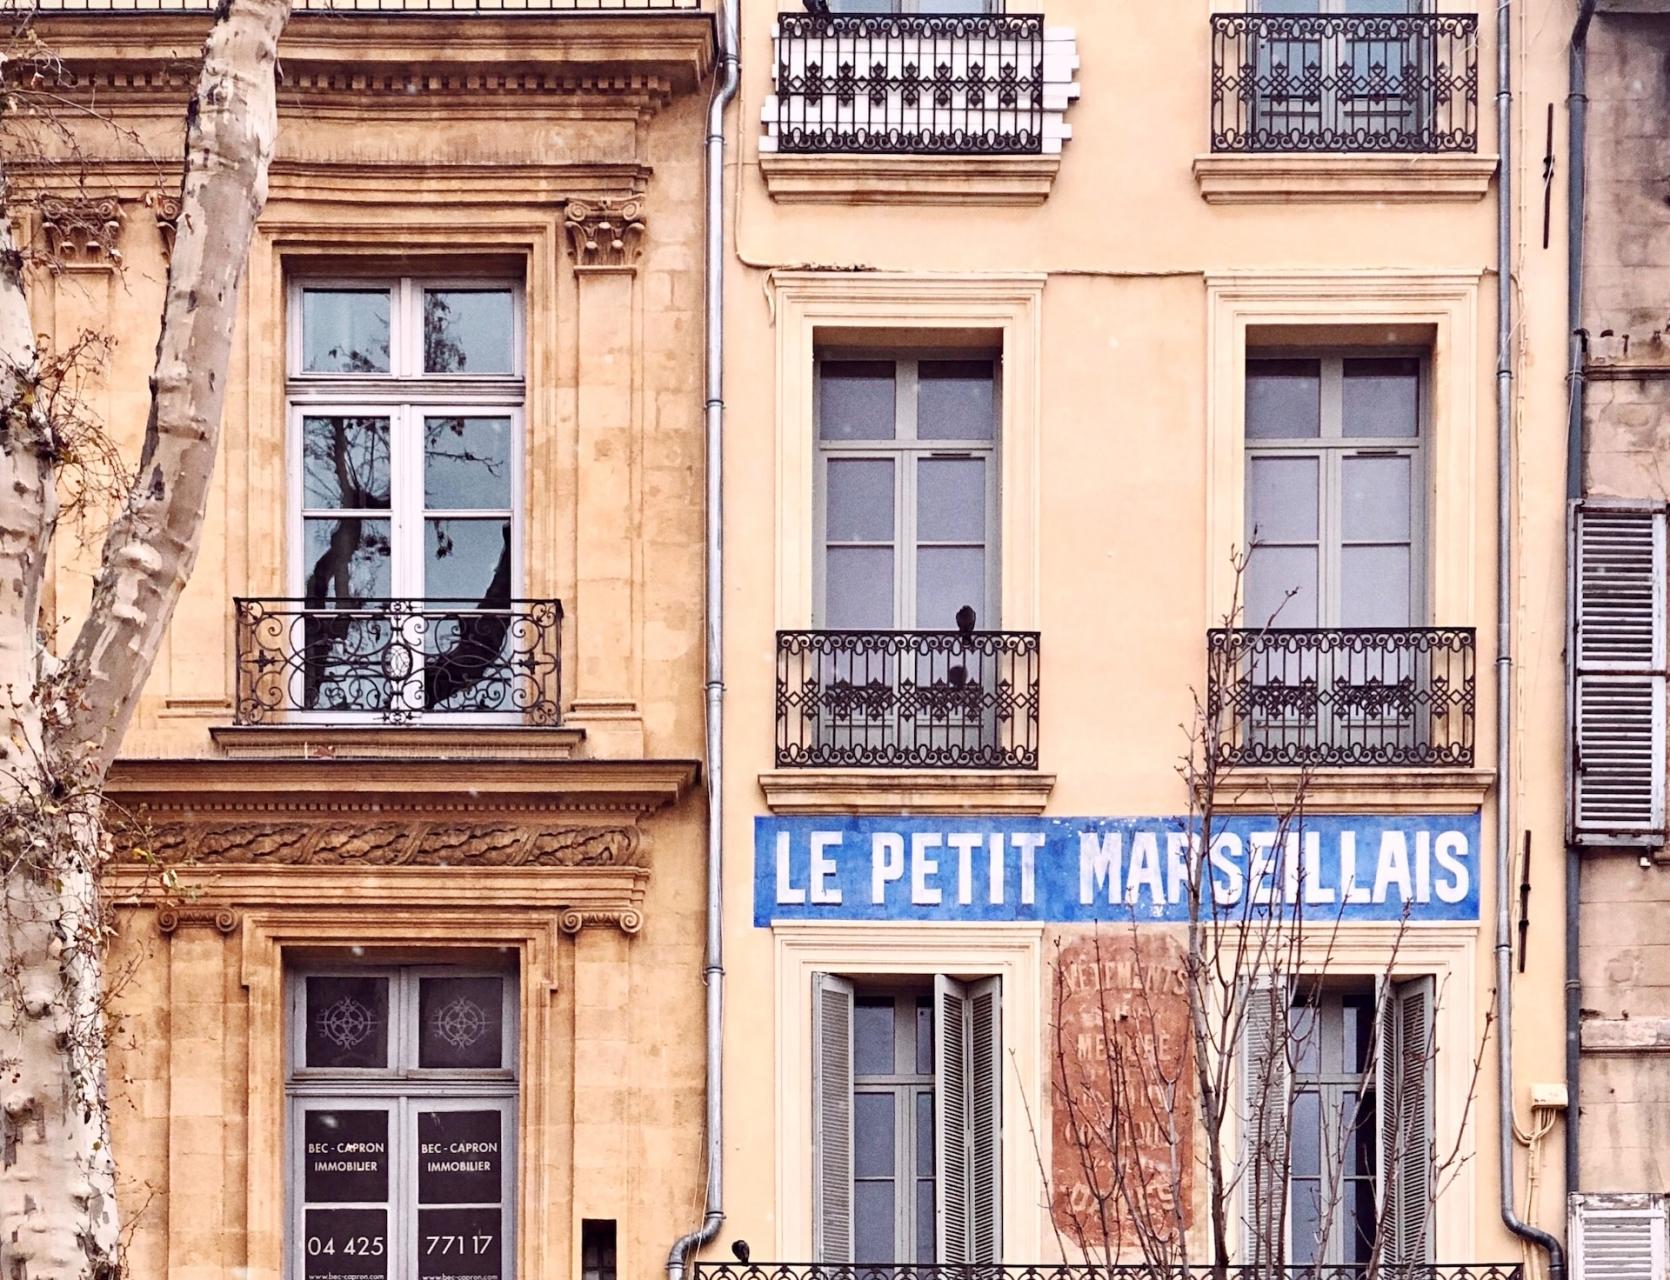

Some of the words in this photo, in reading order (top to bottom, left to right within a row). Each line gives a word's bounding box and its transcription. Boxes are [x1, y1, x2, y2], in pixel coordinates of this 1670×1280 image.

[776, 831, 842, 905] LE
[871, 831, 1046, 905] PETIT
[1078, 831, 1470, 905] MARSEILLAIS
[308, 1143, 329, 1154] BEC
[337, 1143, 384, 1154] CAPRON
[421, 1143, 442, 1154] BEC
[450, 1142, 498, 1153] CAPRON
[314, 1161, 378, 1172] IMMOBILIER
[427, 1161, 491, 1172] IMMOBILIER
[307, 1236, 336, 1256] 04
[343, 1236, 384, 1256] 425
